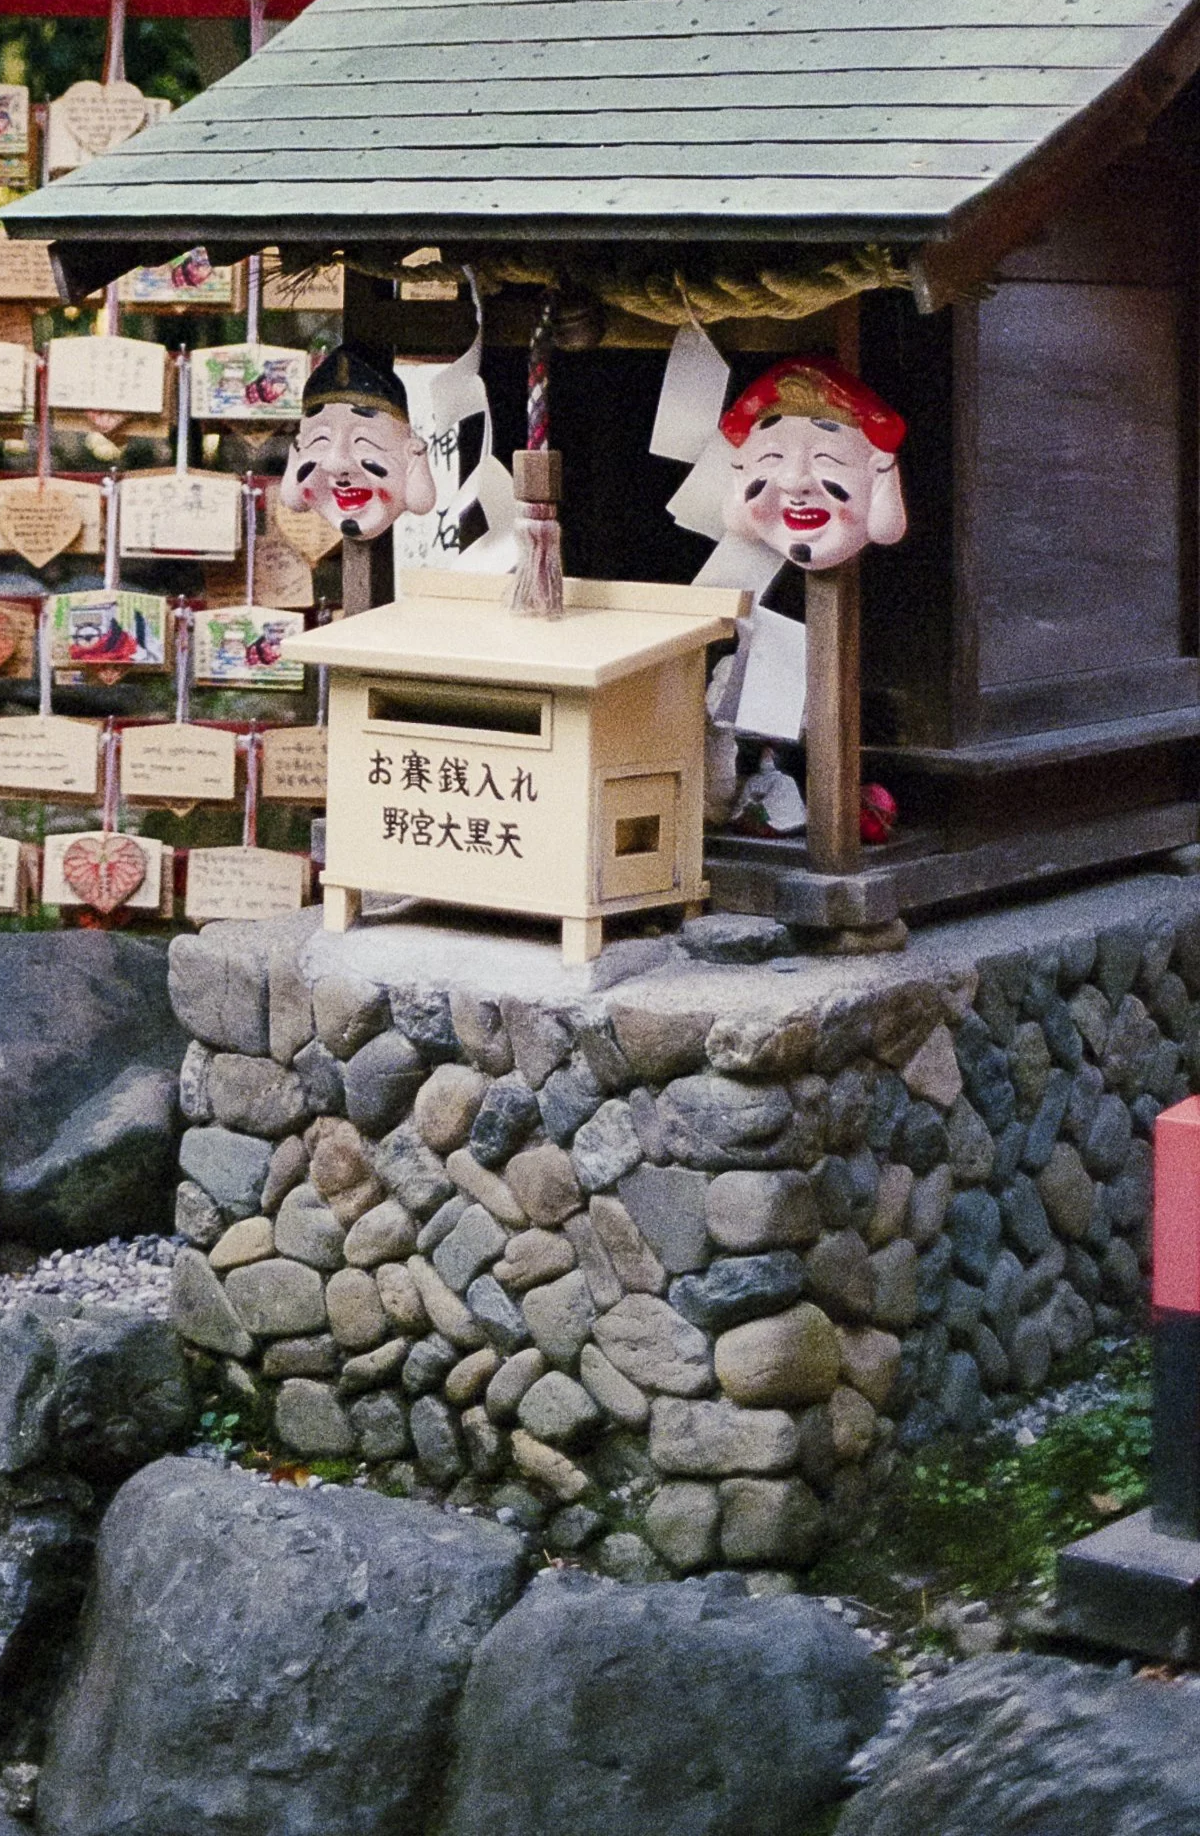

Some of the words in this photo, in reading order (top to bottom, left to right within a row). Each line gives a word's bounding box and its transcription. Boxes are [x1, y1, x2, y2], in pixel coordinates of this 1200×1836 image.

[368, 749, 538, 802] お賽銭入れ
[382, 807, 524, 858] 野宮大黒天
